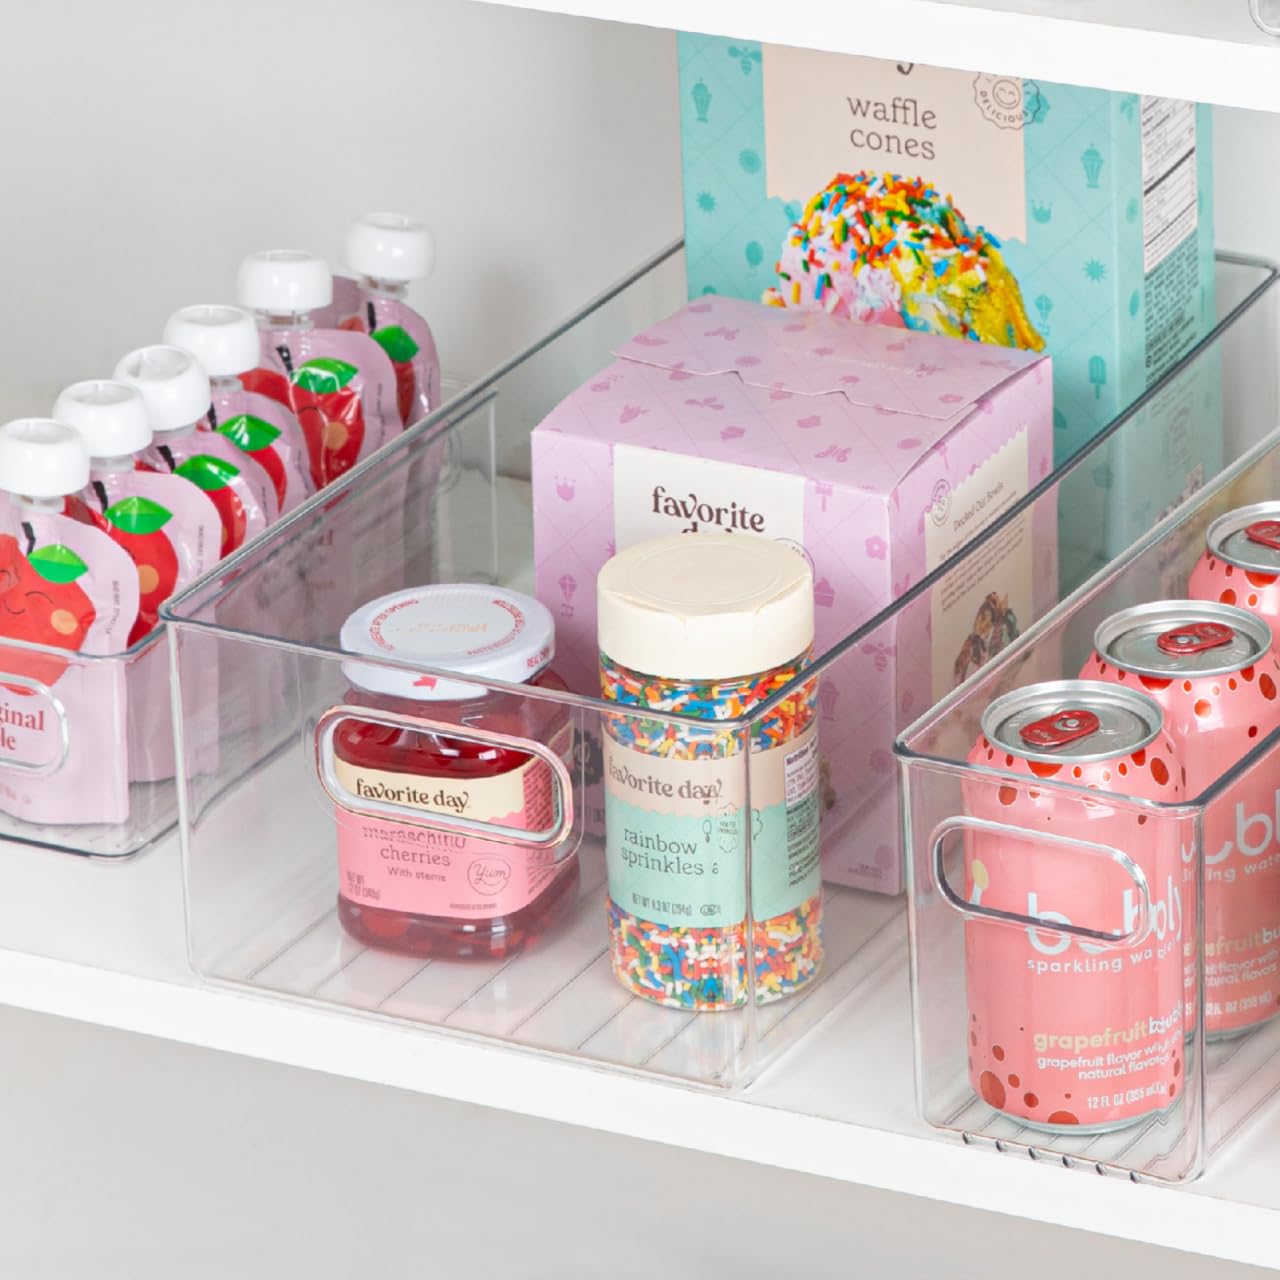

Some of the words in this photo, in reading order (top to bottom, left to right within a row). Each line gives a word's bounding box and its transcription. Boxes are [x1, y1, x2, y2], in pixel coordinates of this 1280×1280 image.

[847, 95, 937, 130] waffle
[850, 126, 936, 161] cones
[652, 486, 764, 532] favorite
[608, 755, 673, 798] favorite
[357, 778, 433, 804] favorite
[435, 789, 470, 813] day
[623, 828, 697, 855] rainbow
[380, 846, 450, 867] cherries
[620, 846, 704, 876] sprinkles
[387, 866, 412, 878] With
[415, 870, 446, 882] stems
[474, 863, 511, 886] Yum
[1027, 956, 1122, 975] sparkling
[1037, 1055, 1107, 1070] grapefruit
[1107, 1048, 1142, 1065] flavor
[1078, 1065, 1127, 1080] natural
[1088, 1095, 1098, 1109] 12
[1099, 1095, 1110, 1108] FL
[1113, 1093, 1125, 1105] OZ
